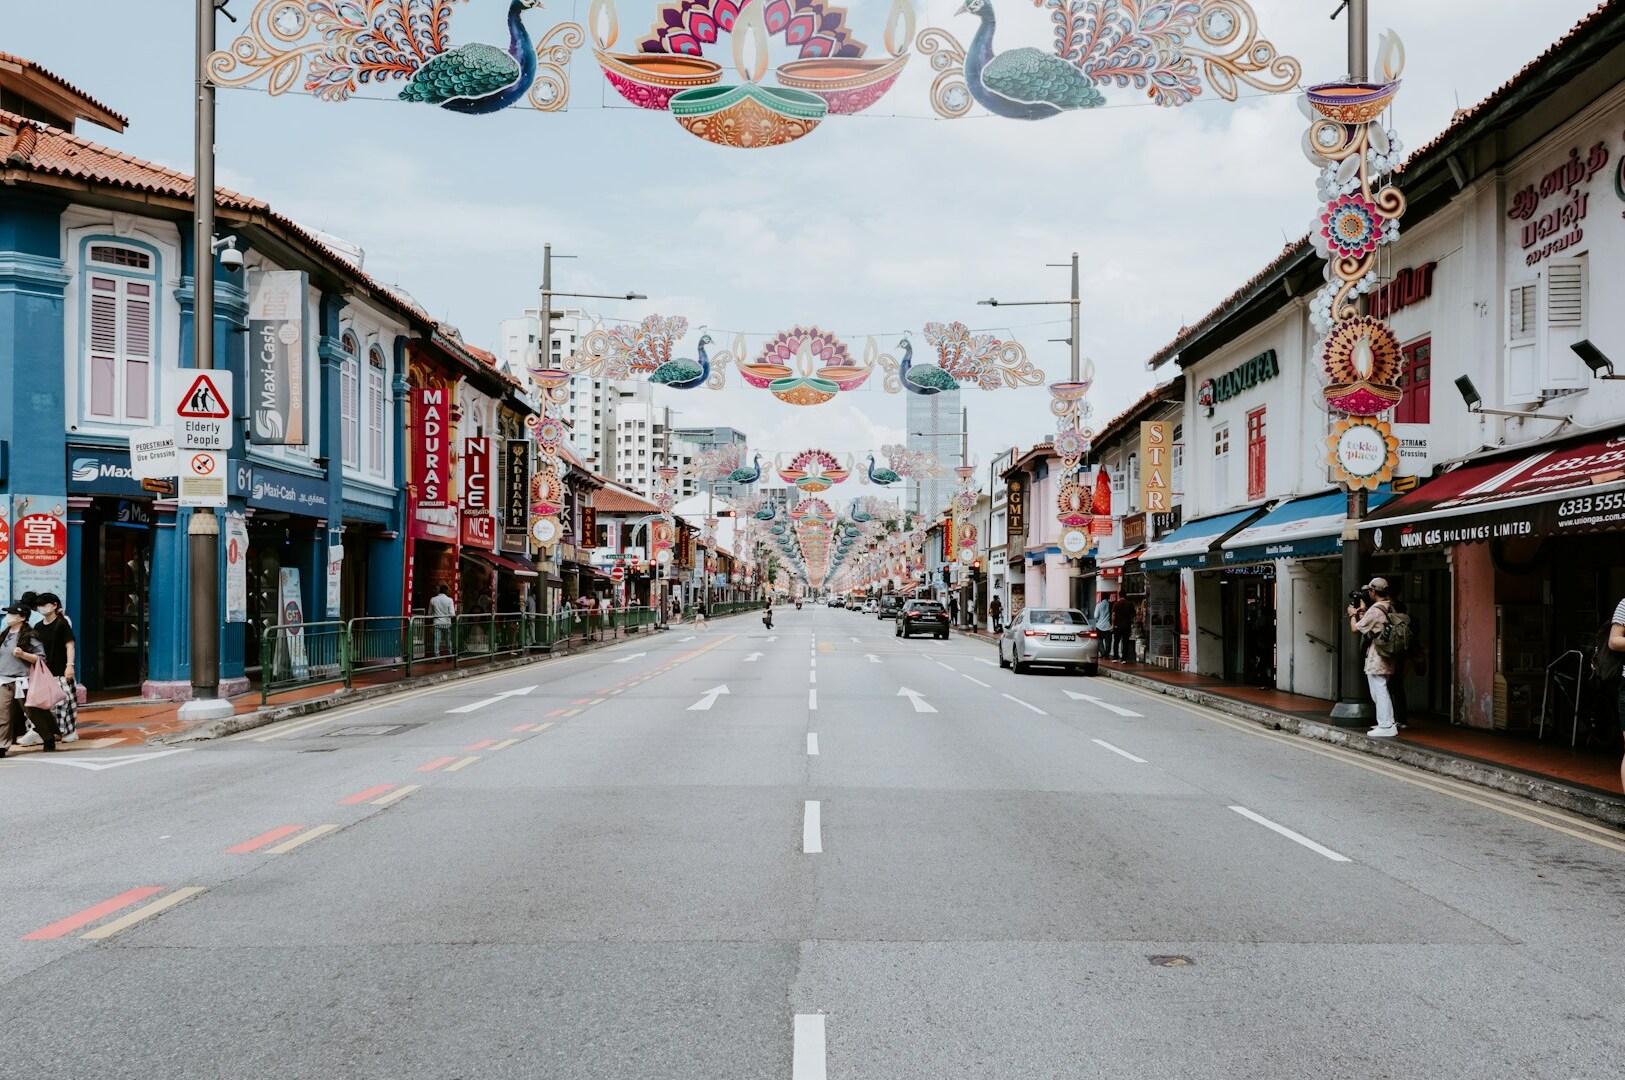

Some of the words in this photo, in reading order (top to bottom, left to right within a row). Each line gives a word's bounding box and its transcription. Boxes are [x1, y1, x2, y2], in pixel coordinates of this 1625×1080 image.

[260, 325, 276, 409] Maxi-Cash
[186, 421, 220, 434] Elderly
[136, 439, 174, 451] PEDESTRIANS
[187, 434, 219, 446] People
[423, 390, 442, 500] MADURAS
[1401, 439, 1427, 447] STRIANS
[137, 453, 148, 461] Use
[150, 450, 176, 460] Crossing
[1400, 450, 1427, 458] Crossing
[467, 439, 485, 507] NICE
[1146, 424, 1167, 510] STAR
[238, 468, 252, 491] 61
[263, 482, 296, 501] Maxi-Cash
[1009, 493, 1021, 526] GMT
[1558, 497, 1592, 516] 6333
[1595, 493, 1625, 512] 555
[24, 517, 57, 547] 當
[469, 517, 490, 539] NICE
[1400, 532, 1422, 547] UNION
[1425, 529, 1441, 544] GAS
[1443, 526, 1490, 541] HOLDINGS
[1494, 521, 1531, 537] LIMITED
